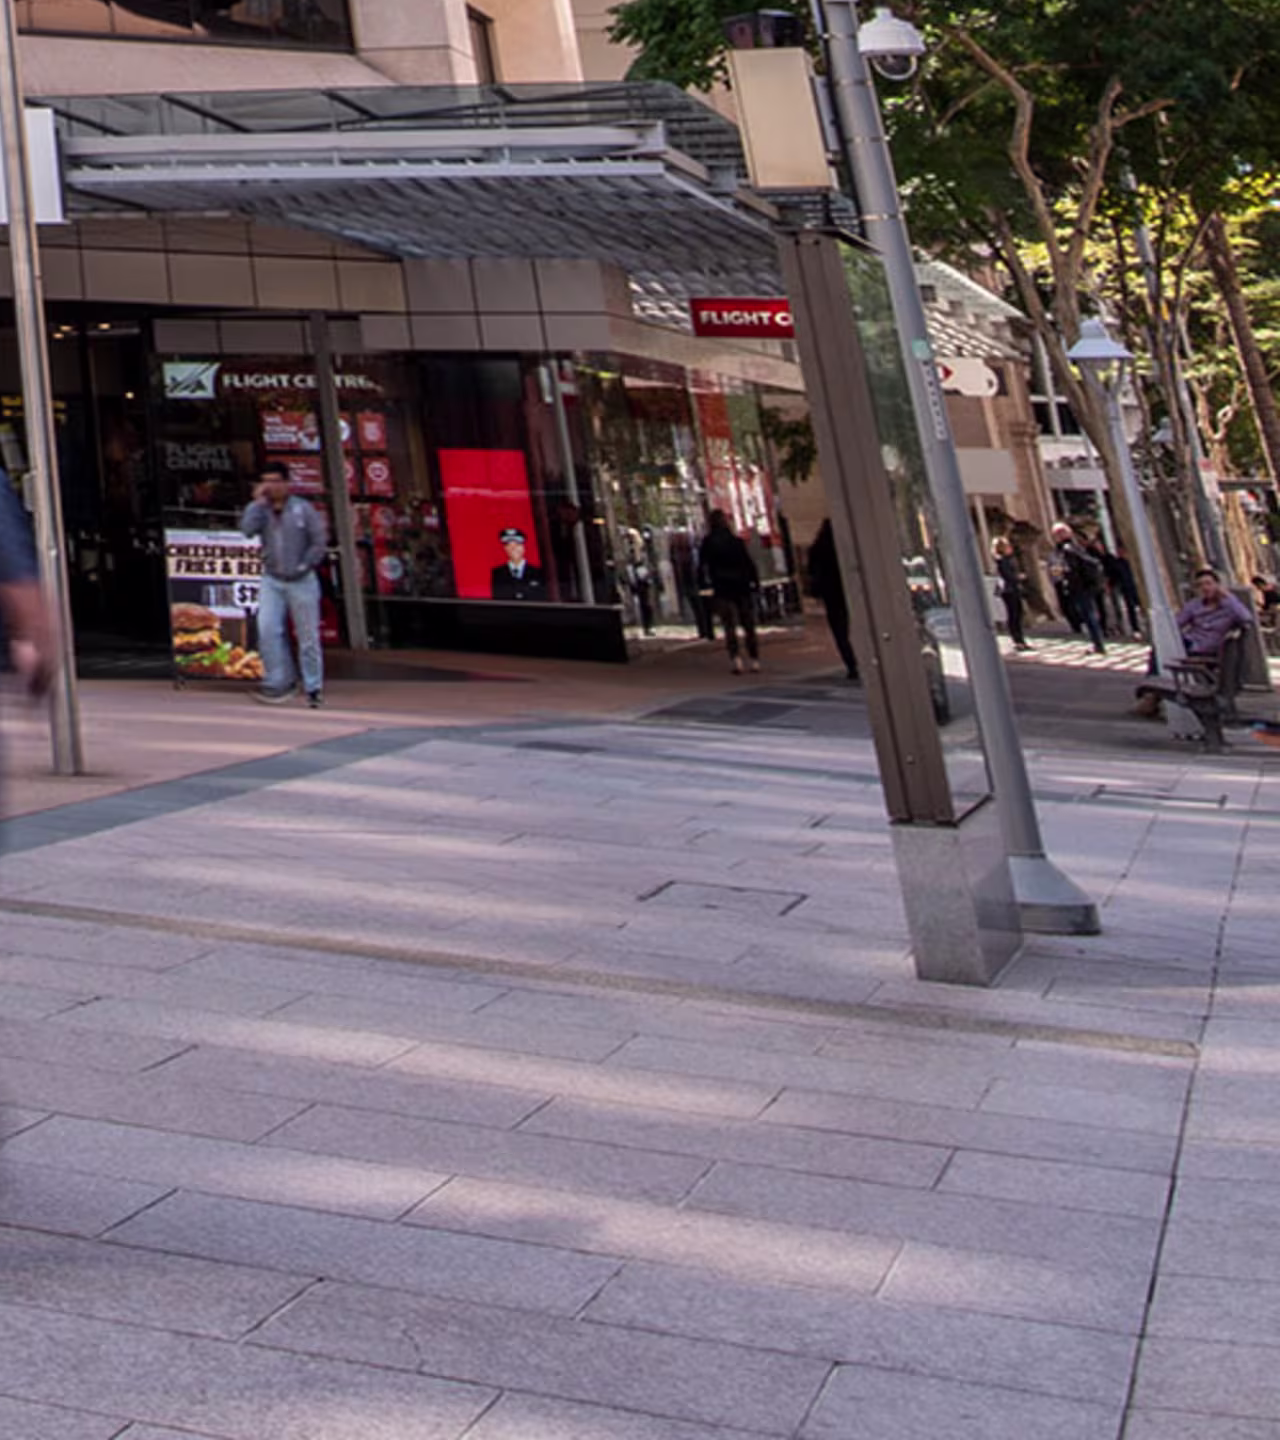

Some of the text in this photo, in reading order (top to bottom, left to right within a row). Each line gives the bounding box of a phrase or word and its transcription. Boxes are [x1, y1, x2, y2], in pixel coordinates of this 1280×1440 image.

[699, 310, 772, 326] FLIGHT
[221, 373, 376, 389] FLIGHT CETRE
